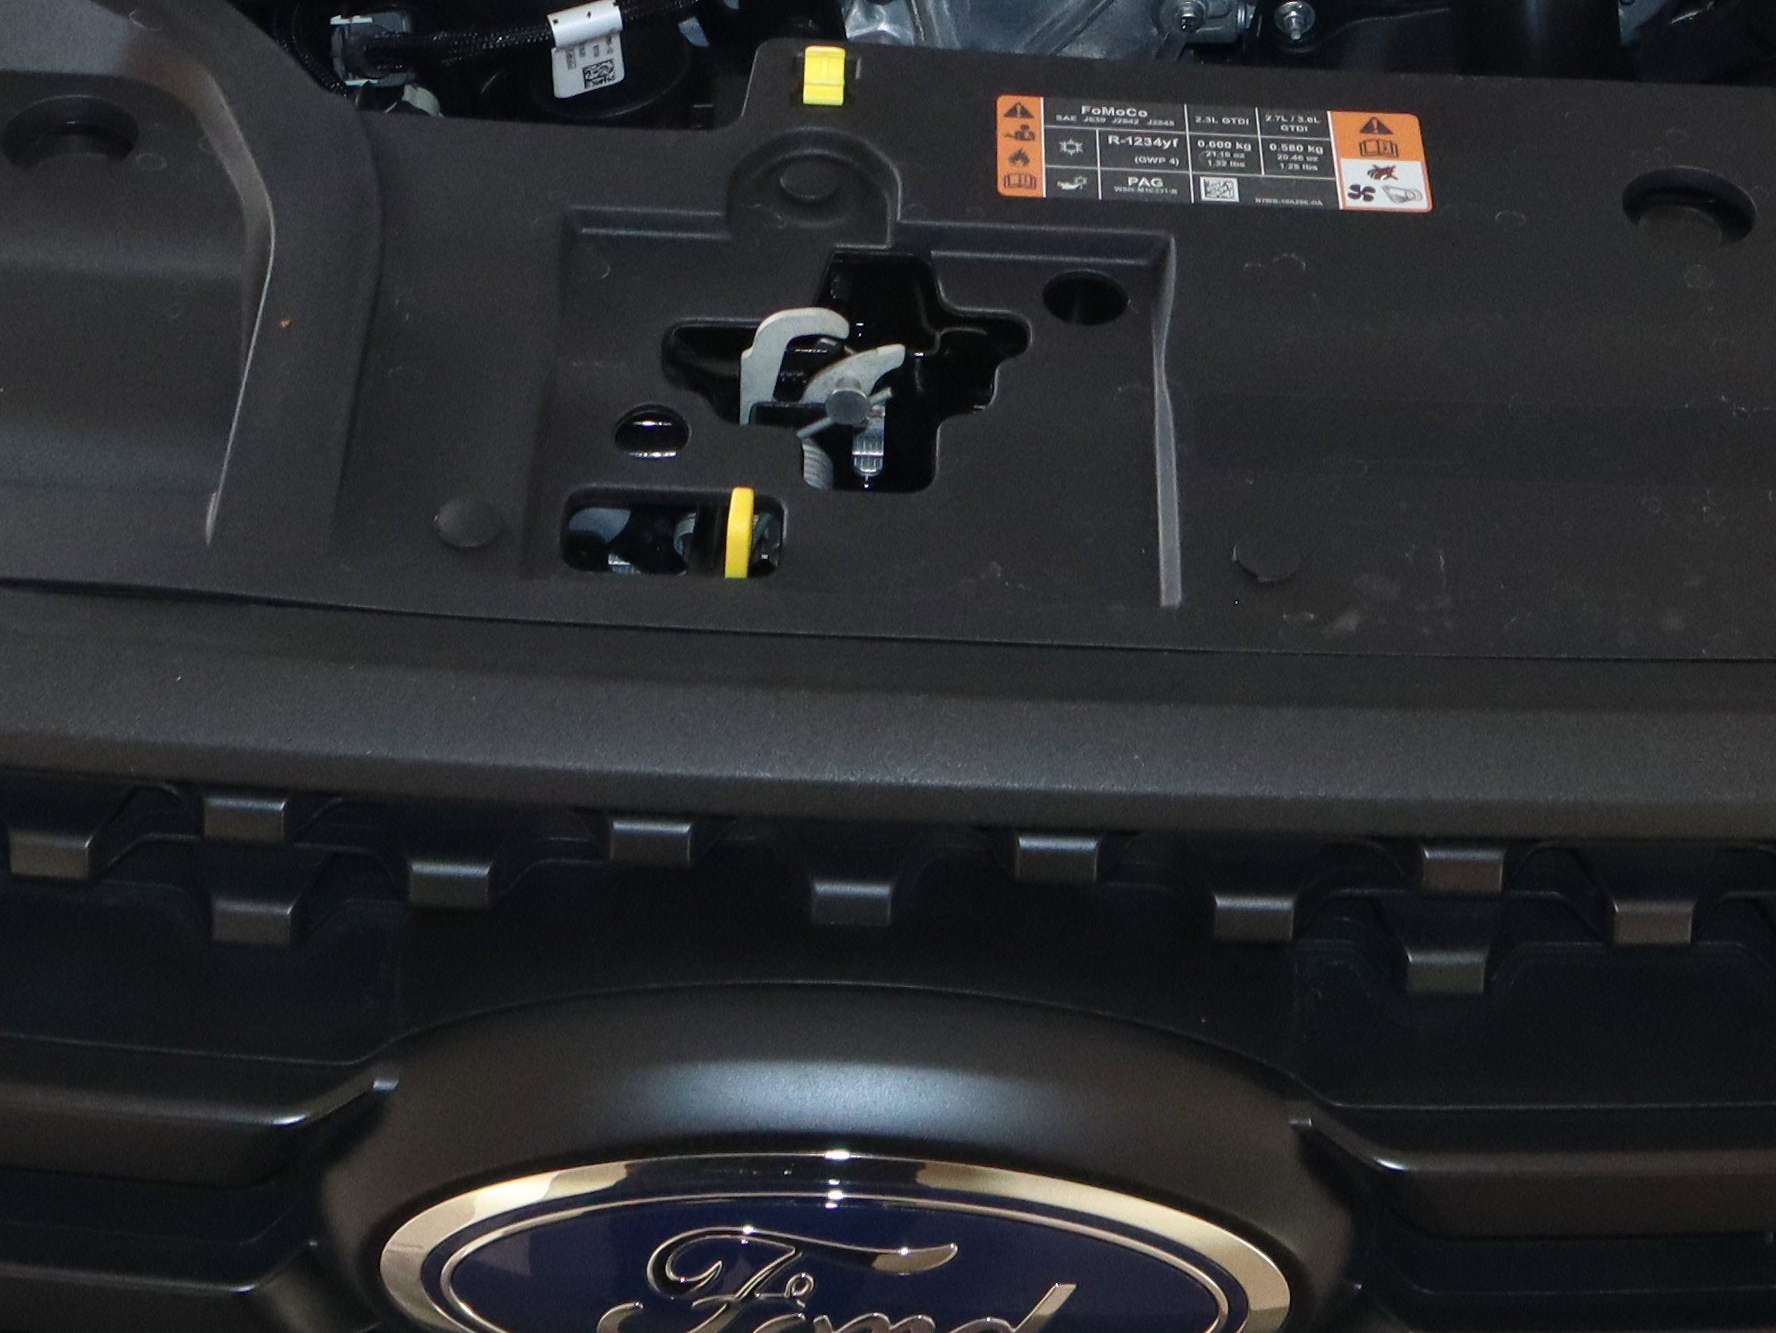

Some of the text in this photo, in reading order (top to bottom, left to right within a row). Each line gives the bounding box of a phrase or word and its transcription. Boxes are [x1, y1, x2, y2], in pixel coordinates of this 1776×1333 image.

[1081, 105, 1148, 118] FoMoCo
[1055, 114, 1077, 122] SAE
[1195, 115, 1250, 126] 2.3L GTDI
[1265, 114, 1289, 123] 2.7L
[1297, 115, 1321, 124] 3.0L
[1280, 124, 1308, 133] GTDI
[1107, 134, 1179, 150] R-1234yf
[1197, 139, 1252, 152] 0.600 kg
[1269, 143, 1324, 155] 0.580 kg
[1134, 156, 1166, 165] (GWP
[1127, 176, 1164, 188] PAG
